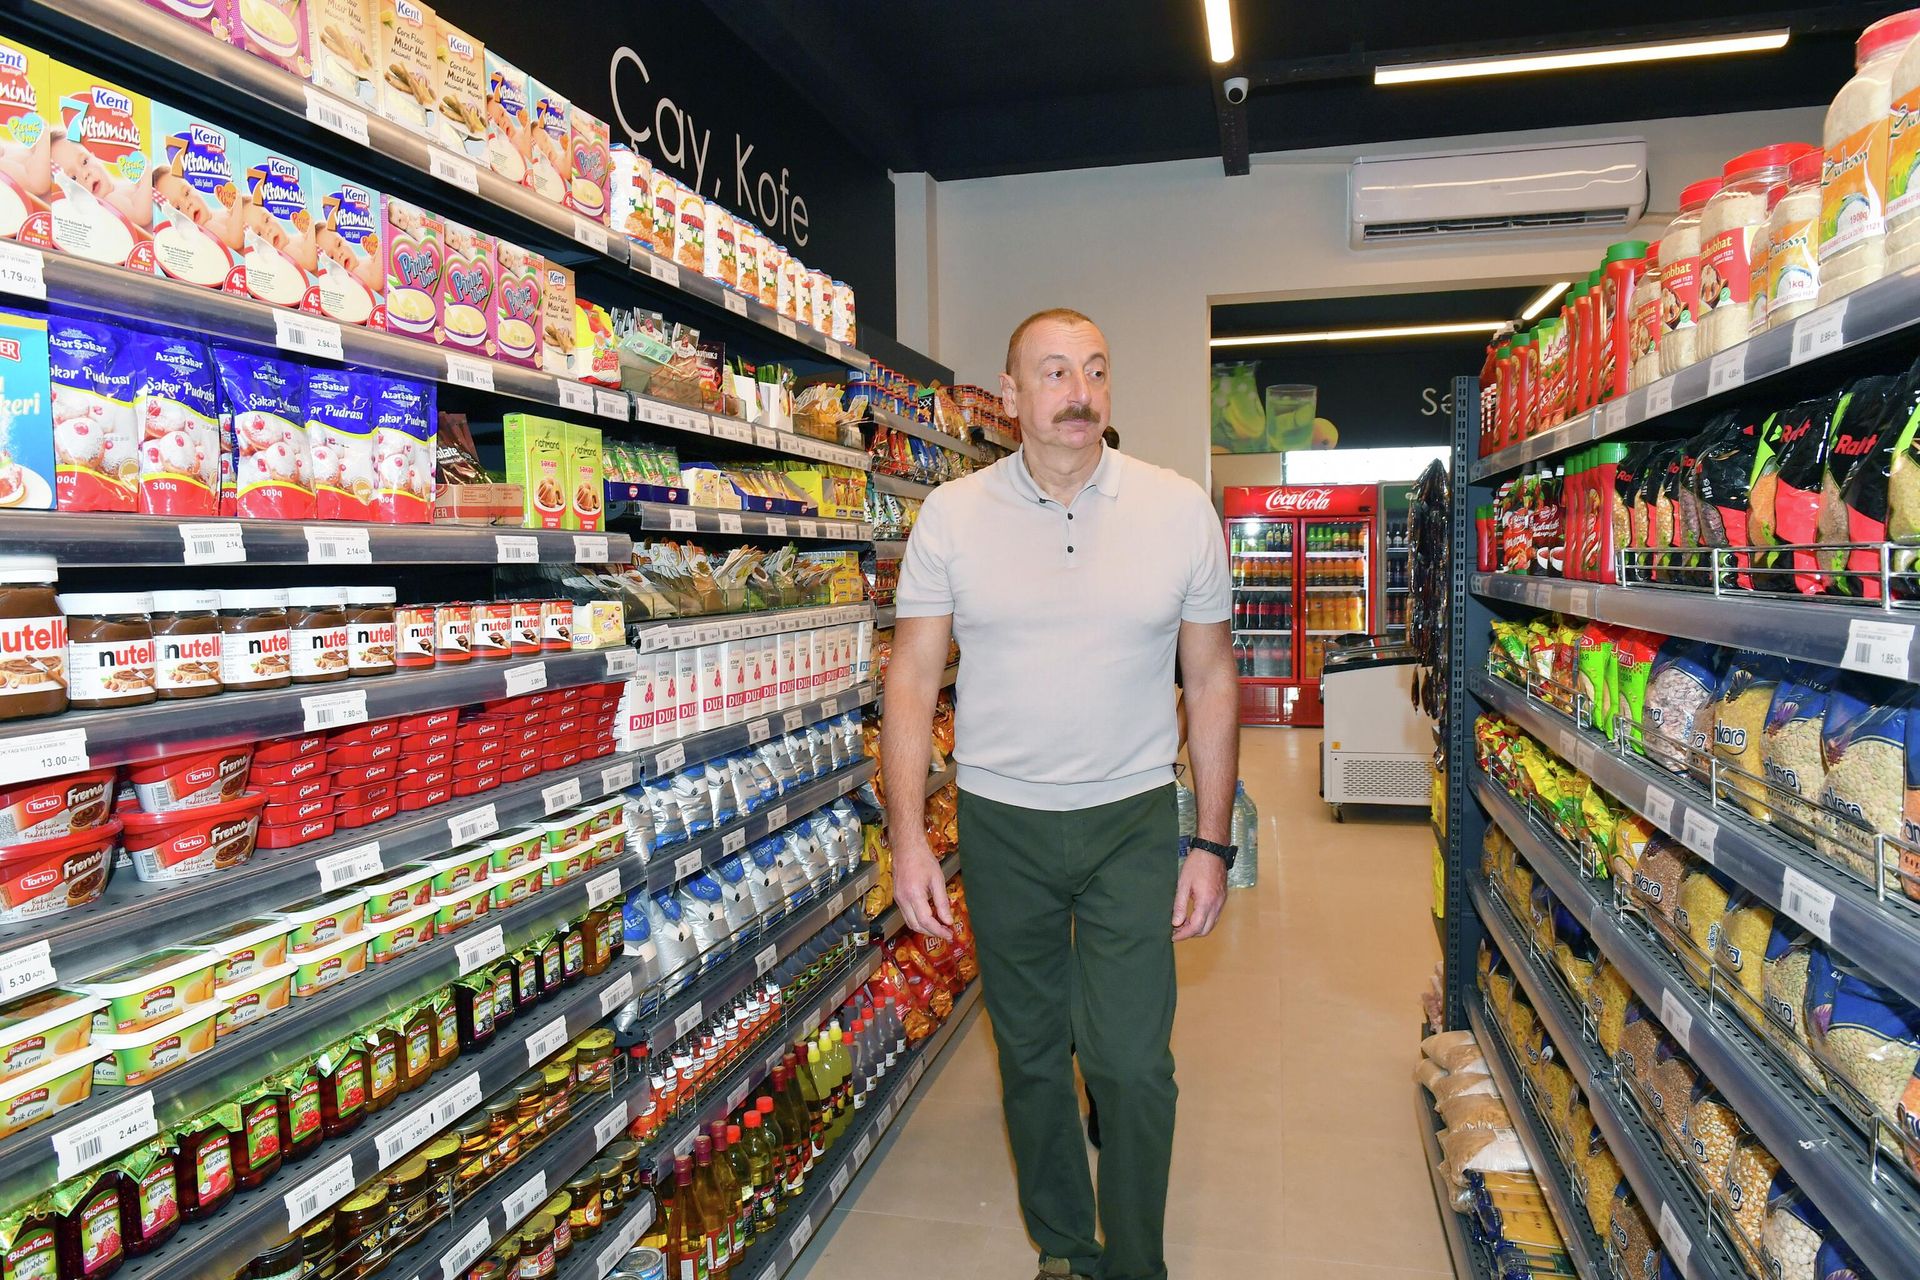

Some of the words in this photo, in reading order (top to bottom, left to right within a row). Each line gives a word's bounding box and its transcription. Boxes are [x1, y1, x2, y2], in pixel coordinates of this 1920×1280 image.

[397, 2, 420, 22] Kent
[450, 36, 472, 54] Kent
[0, 51, 23, 69] ent
[95, 90, 129, 111] Kent
[60, 96, 90, 143] 7
[194, 128, 222, 146] Kent
[165, 136, 189, 178] 7
[271, 160, 296, 176] Kent
[247, 167, 267, 206] 7
[736, 133, 809, 247] Kofe
[345, 188, 367, 203] Kent
[322, 196, 341, 232] 7
[2, 269, 23, 282] 1.79
[549, 271, 565, 285] Kent
[50, 366, 79, 380] əkər
[1421, 388, 1451, 416] Sə
[378, 414, 402, 424] əkər
[57, 475, 77, 486] 00q
[153, 482, 177, 492] 300q
[0, 619, 69, 653] utell
[411, 626, 433, 638] nute
[449, 622, 470, 635] nute
[573, 633, 590, 643] Kent
[99, 640, 155, 667] nutell
[164, 636, 221, 660] nutell
[763, 685, 776, 697] DUZ
[706, 698, 722, 711] DUZ
[728, 694, 743, 707] DUZ
[658, 708, 676, 723] DUZ
[681, 703, 698, 717] DUZ
[633, 713, 652, 729] DUZ
[41, 756, 67, 768] 13.00
[189, 769, 214, 782] Torku
[219, 755, 248, 777] Frema
[31, 798, 58, 811] Torku
[67, 784, 104, 806] Frema
[177, 837, 202, 850] Torku
[211, 820, 248, 843] Frema
[25, 872, 55, 887] Torku
[63, 853, 103, 878] Frema
[358, 863, 371, 873] 1.40
[9, 972, 32, 988] 5.30
[24, 1053, 42, 1067] Cemi
[25, 1104, 45, 1119] Cemi
[118, 1125, 138, 1140] 2.44
[199, 1144, 216, 1158] Bizim
[215, 1135, 230, 1149] Tarla
[141, 1173, 159, 1188] Bizim
[159, 1163, 175, 1178] Tarla
[329, 1182, 342, 1197] 3.40
[83, 1204, 104, 1221] Bizim
[104, 1196, 119, 1211] Tarla
[7, 1240, 33, 1262] Bizim
[33, 1233, 53, 1249] Tarla
